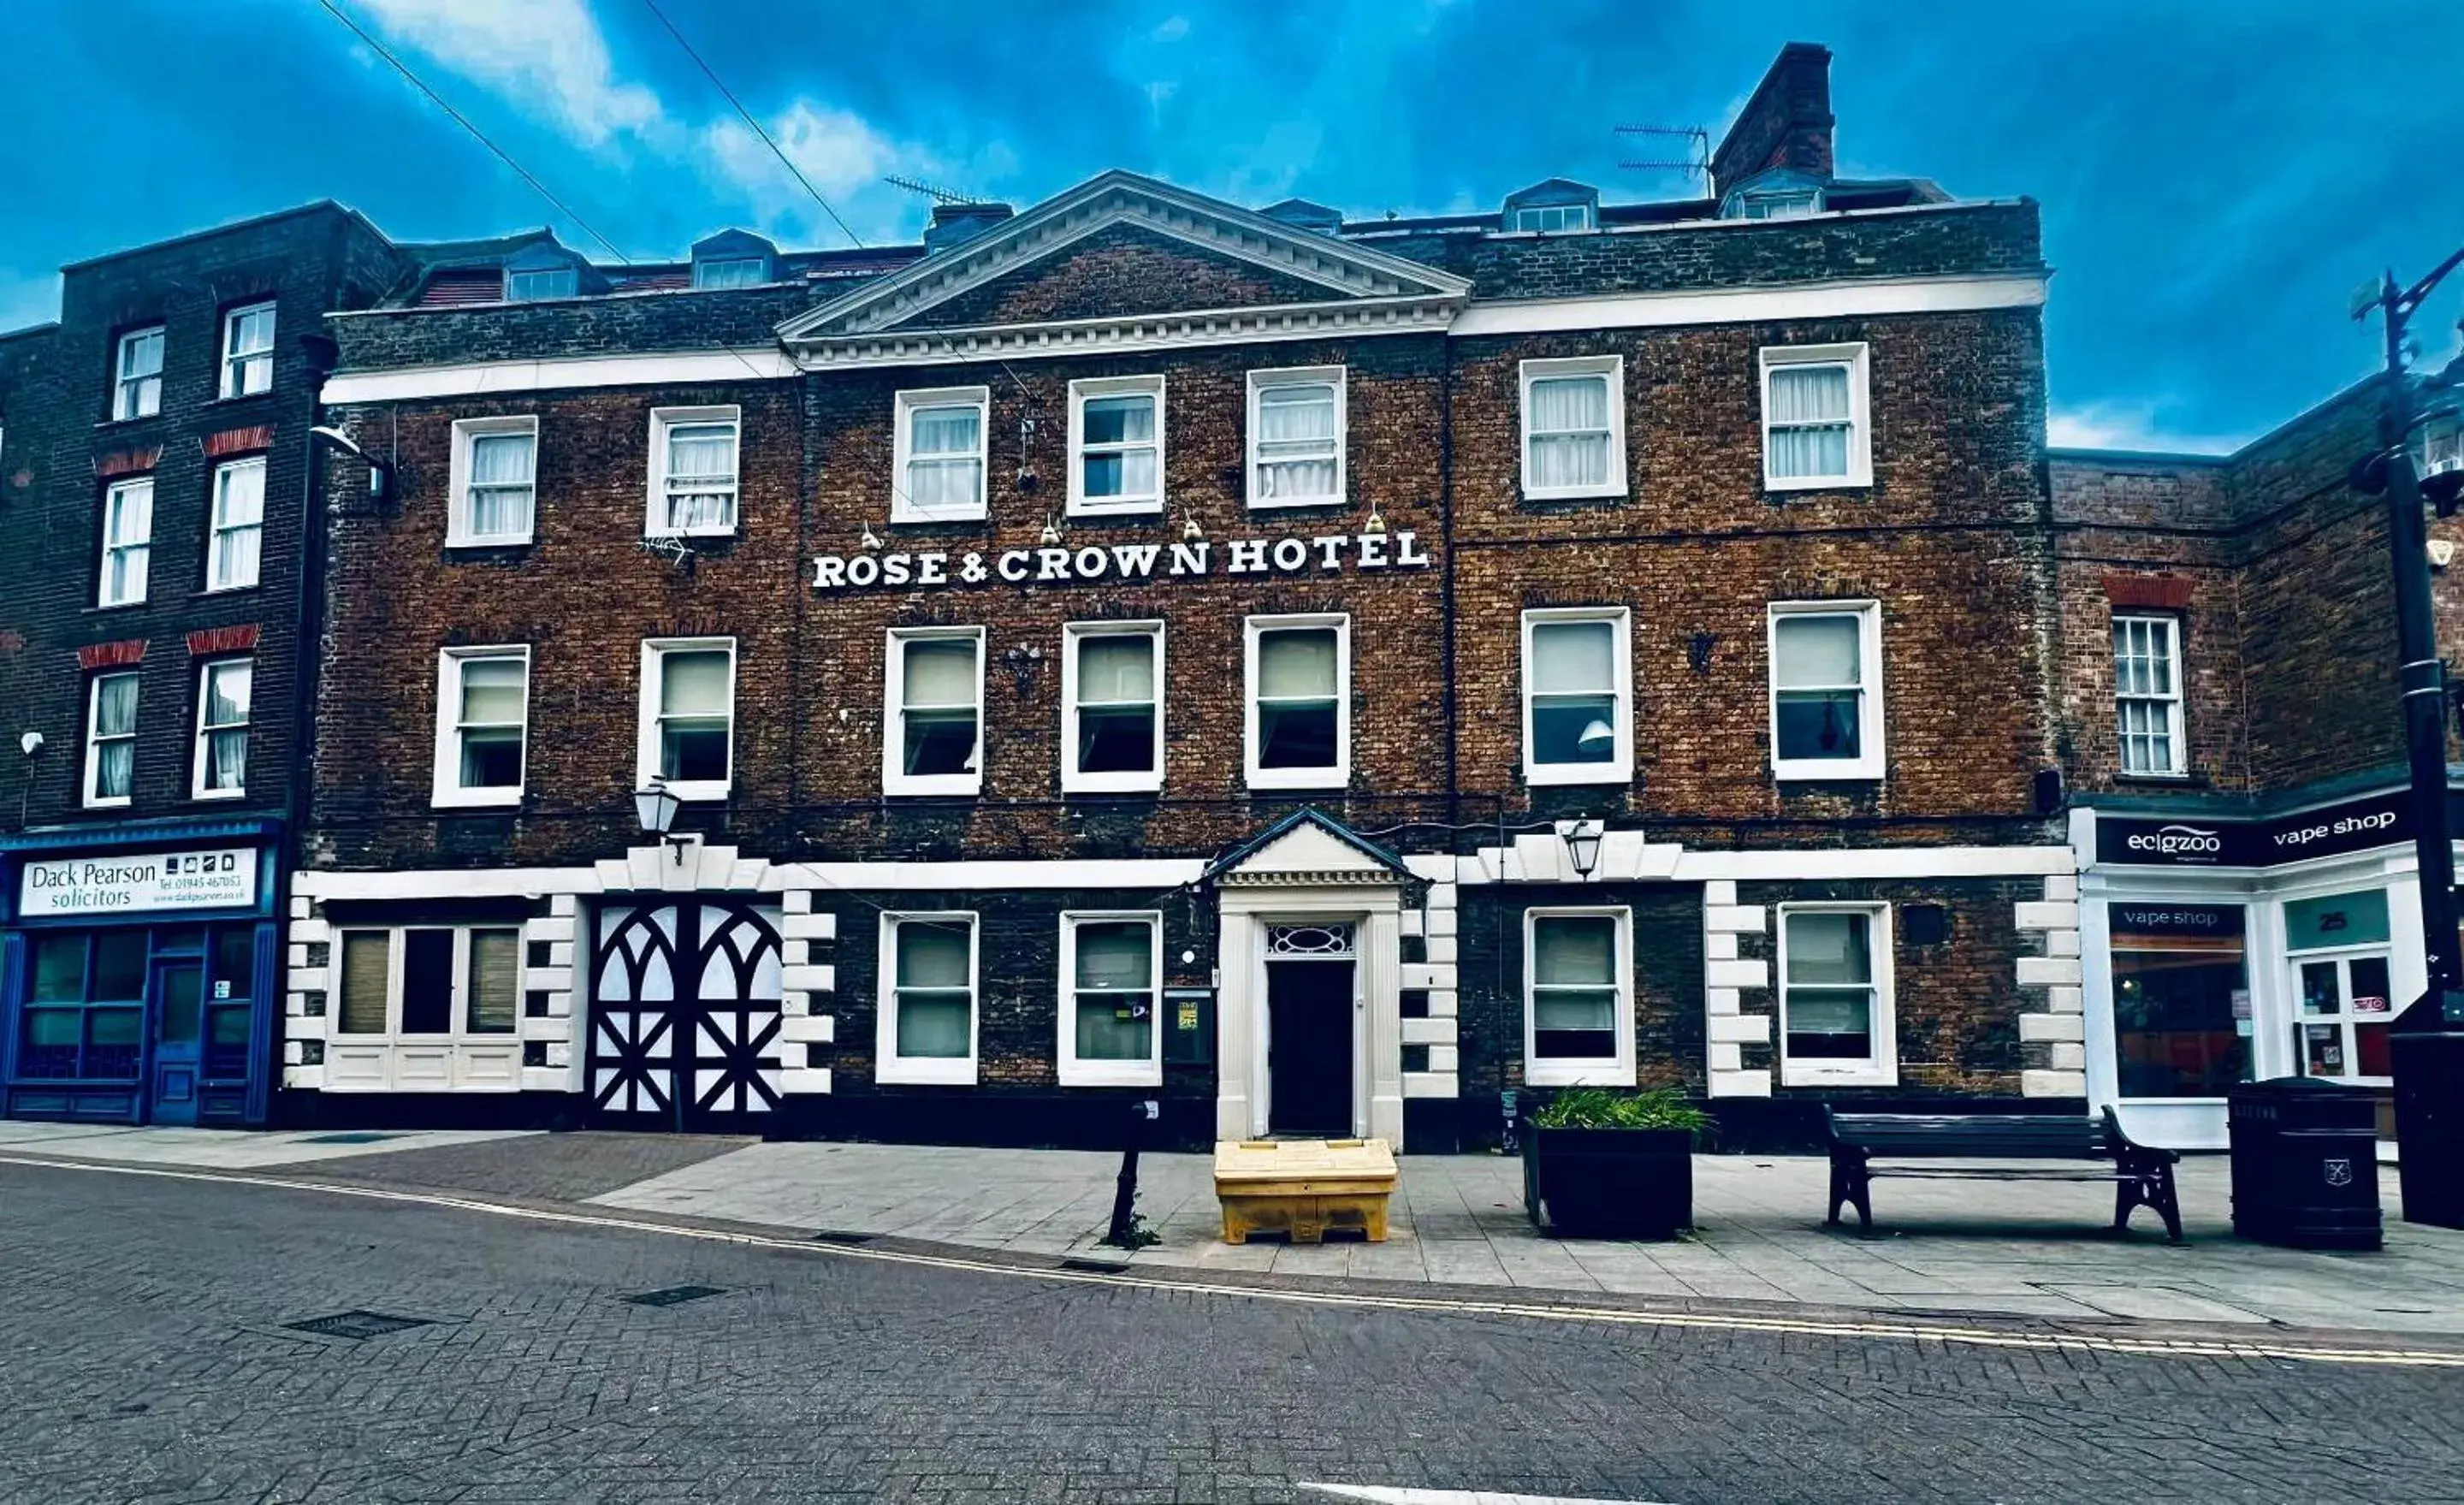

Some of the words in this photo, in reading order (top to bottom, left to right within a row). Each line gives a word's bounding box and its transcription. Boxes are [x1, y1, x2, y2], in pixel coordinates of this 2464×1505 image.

[813, 552, 947, 587] ROSE
[960, 552, 987, 582] &
[998, 542, 1210, 581] CROWN
[1228, 531, 1430, 574] HOTEL
[2273, 825, 2329, 845] vape
[2333, 811, 2396, 834] shop
[2128, 832, 2221, 853] ecigzoo
[32, 862, 77, 888] Dack
[84, 863, 156, 886] Pearson
[51, 888, 131, 908] solicitors
[2123, 912, 2171, 926] vape
[2174, 911, 2218, 927] shop
[2319, 911, 2348, 932] 25
